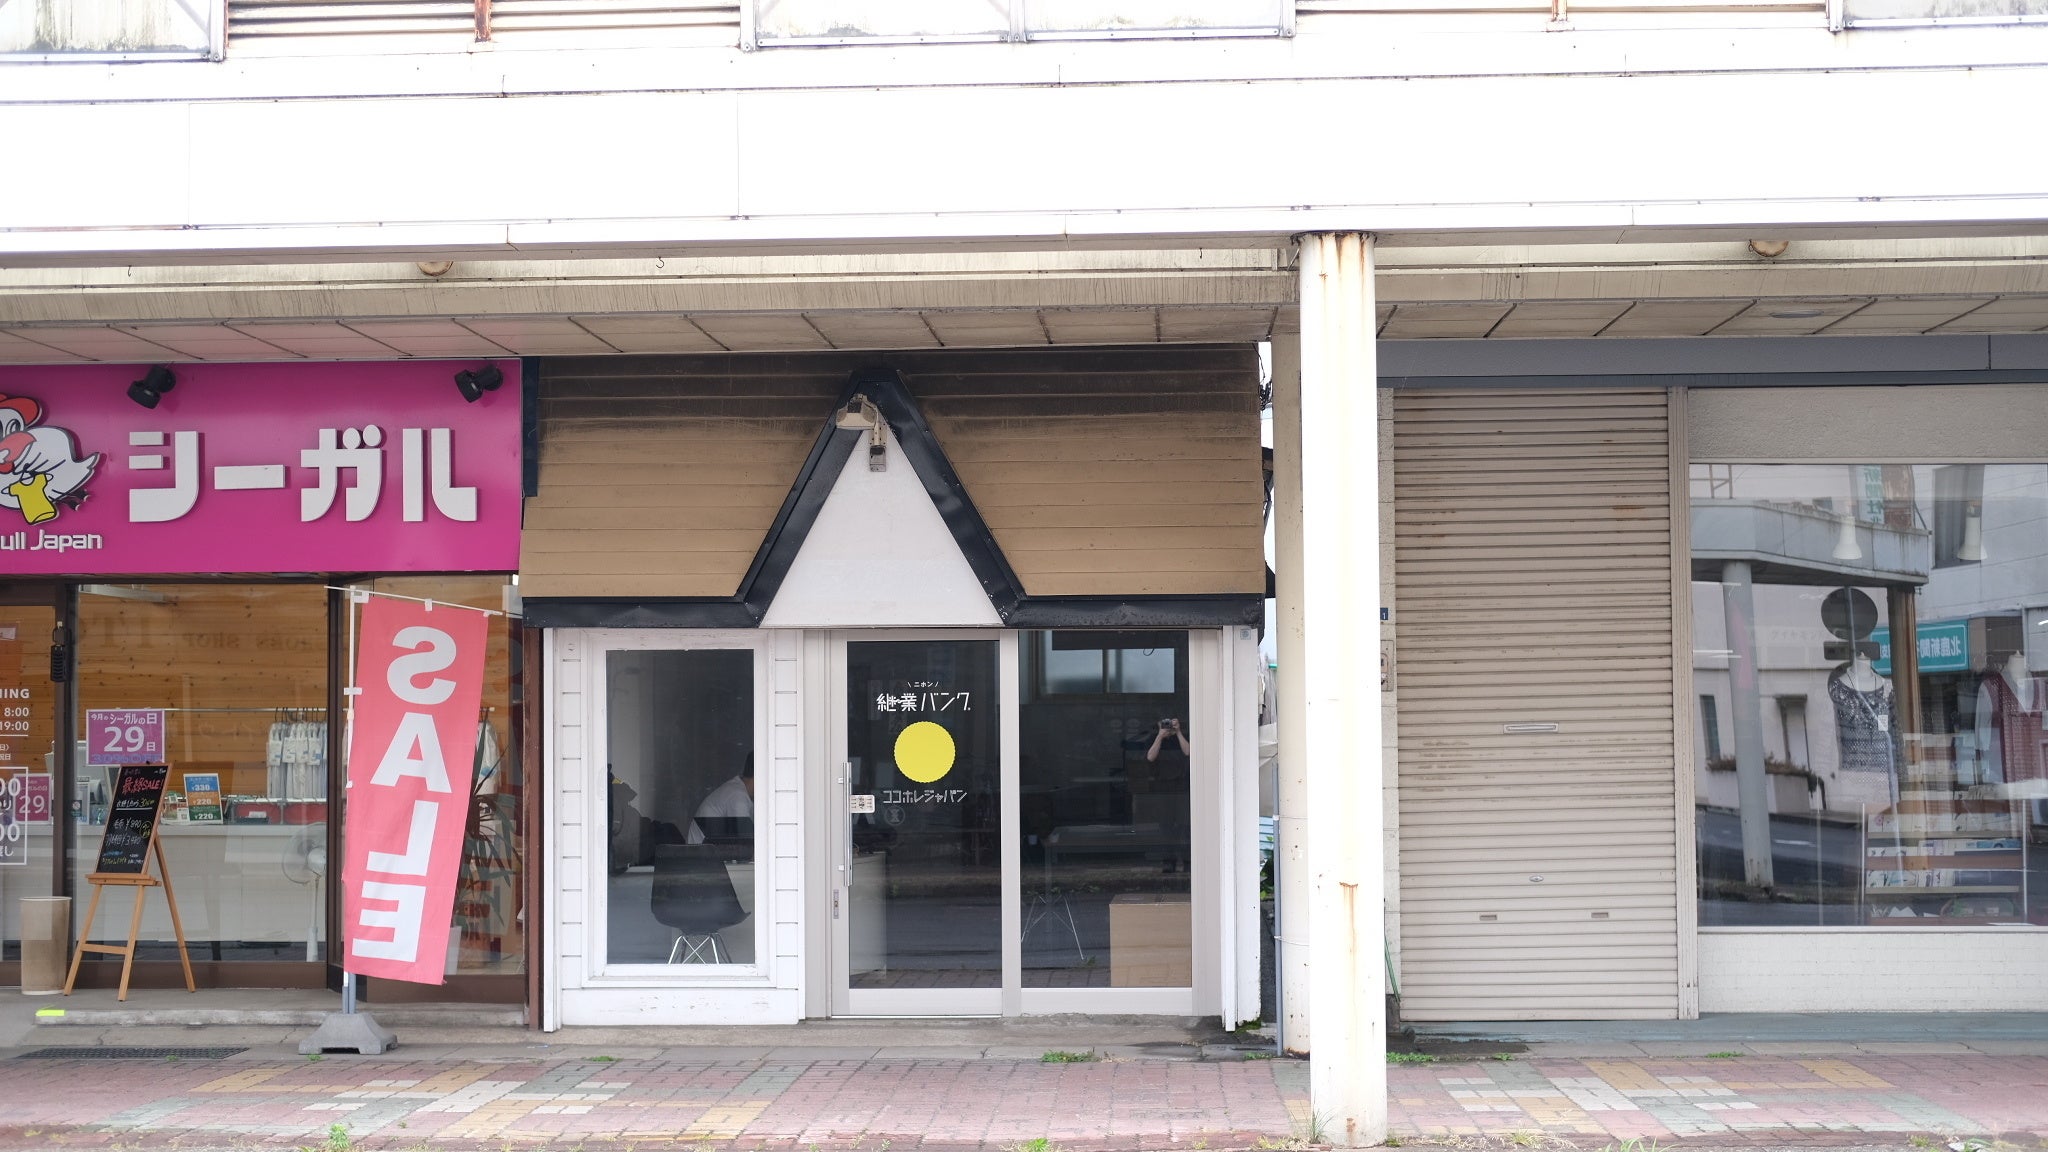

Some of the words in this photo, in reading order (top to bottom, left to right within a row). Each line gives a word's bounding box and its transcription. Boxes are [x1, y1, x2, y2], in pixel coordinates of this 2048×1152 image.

[129, 424, 478, 522] シーガル
[30, 529, 102, 553] Japan
[876, 692, 970, 712] 継業バンク
[4, 707, 29, 717] 8:00
[91, 712, 158, 725] 今月のシーガルの日
[883, 790, 968, 804] ココホレジャパン
